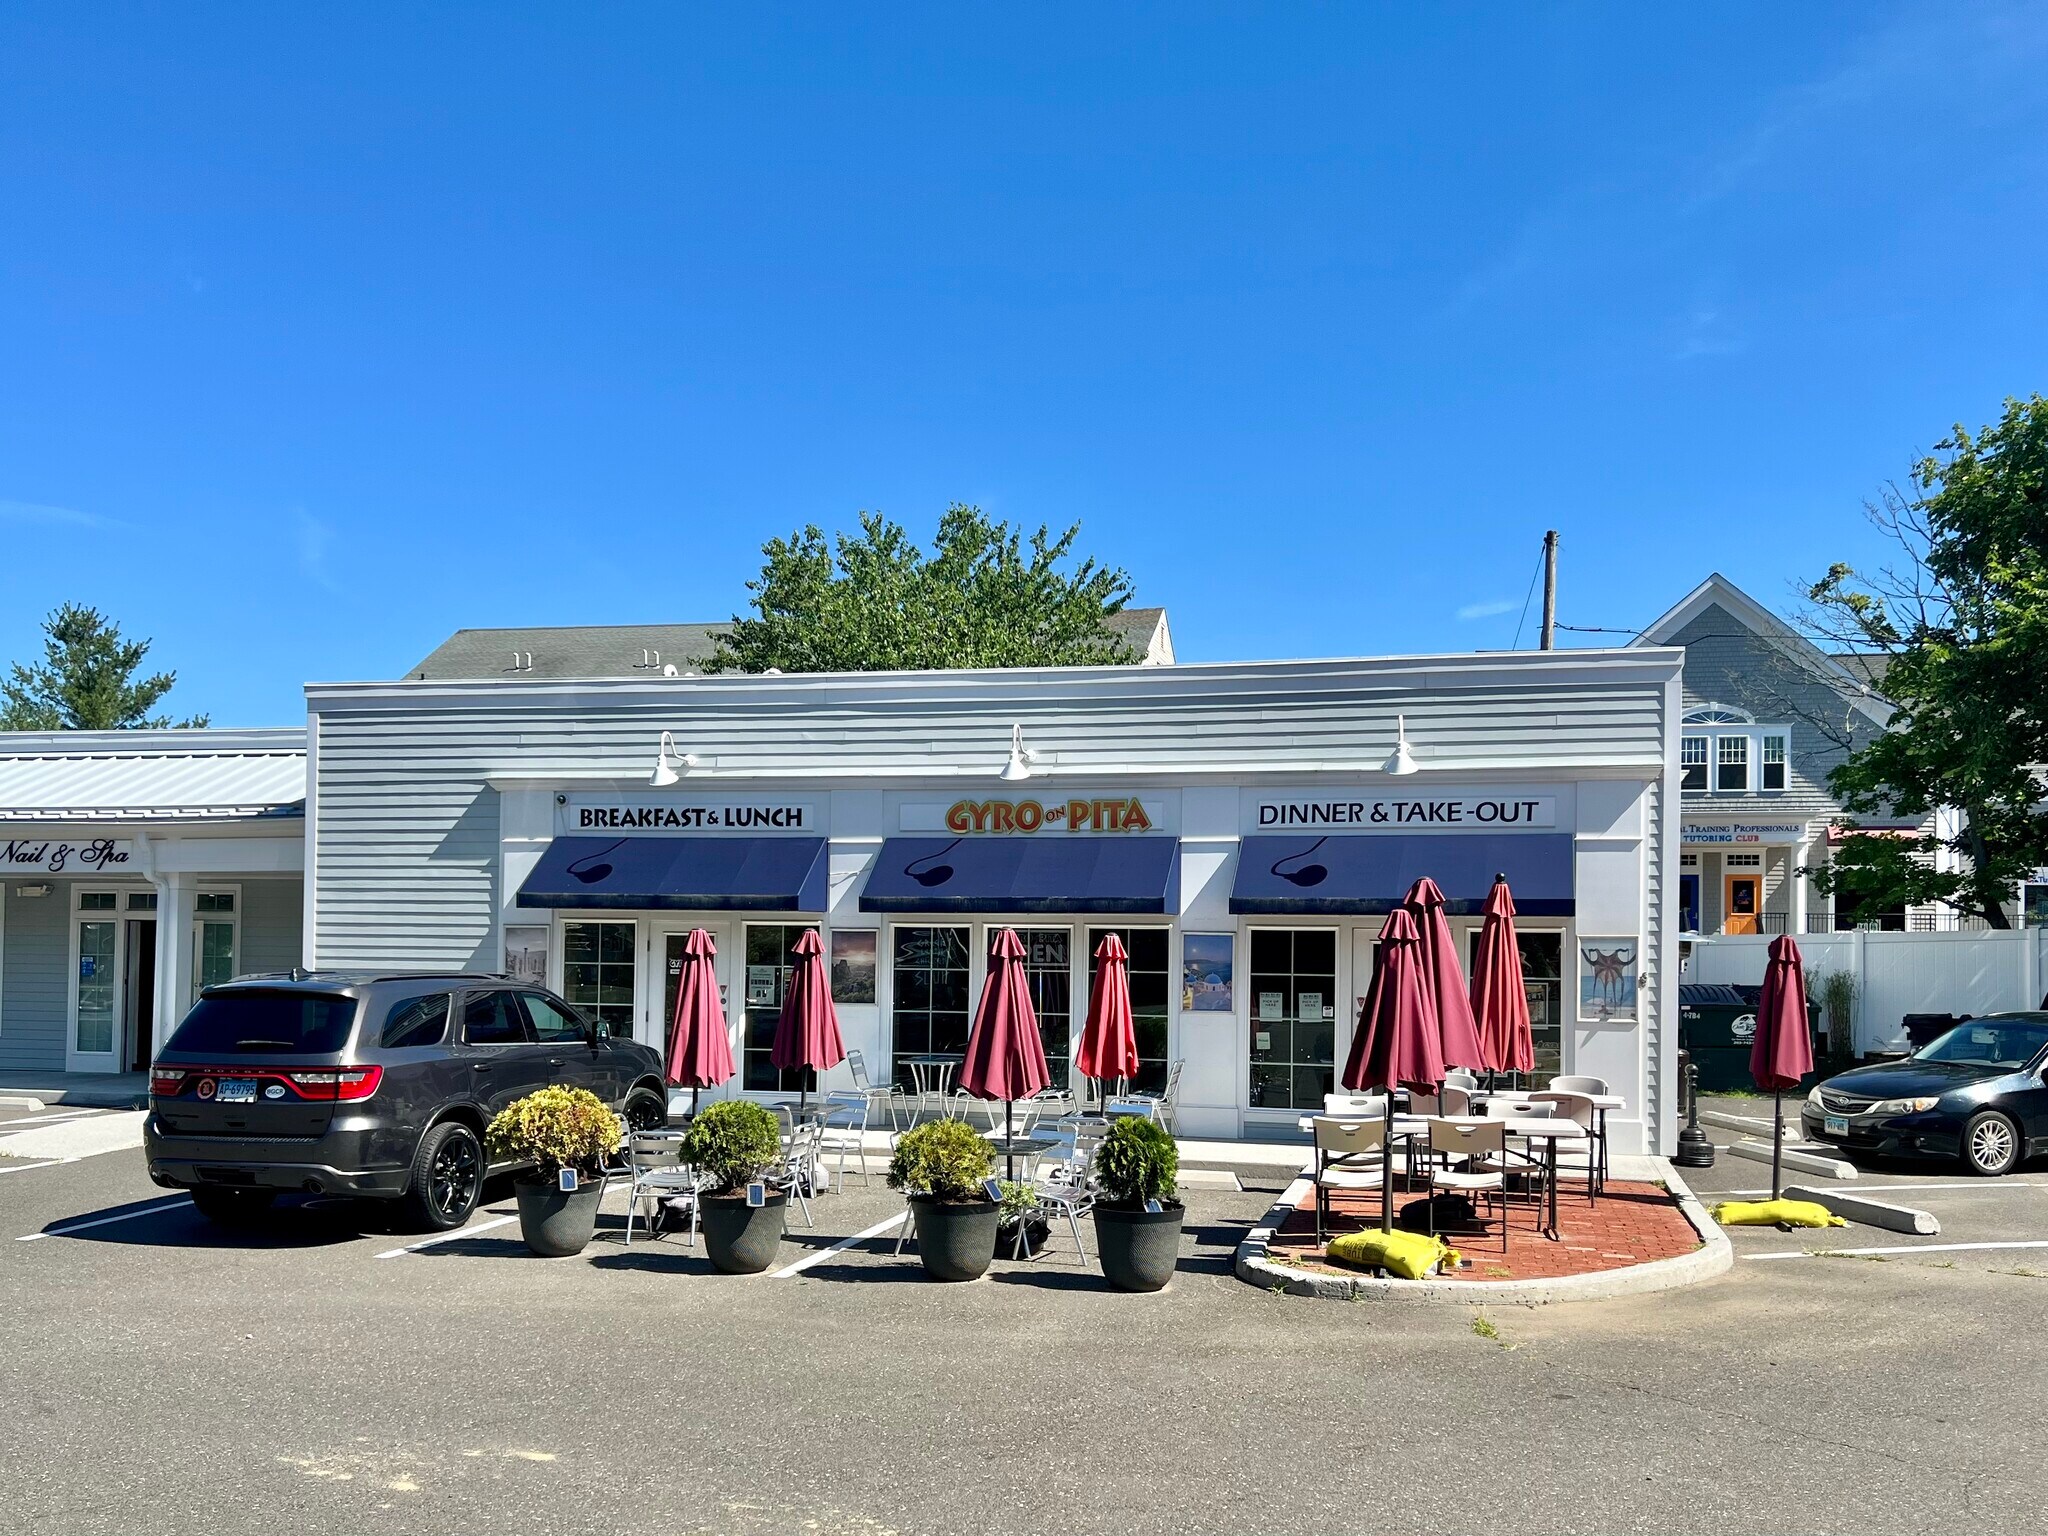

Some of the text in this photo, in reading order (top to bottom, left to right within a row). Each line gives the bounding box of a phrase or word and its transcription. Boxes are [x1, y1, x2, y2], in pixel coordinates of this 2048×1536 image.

[580, 808, 706, 828] BREAKFAST
[724, 807, 803, 827] LUNCH
[945, 797, 1153, 834] GYRO ON PITA
[1259, 803, 1364, 825] DINNER
[1392, 801, 1540, 823] TAKE-OUT
[1683, 834, 1760, 843] TUTORING CLUB
[0, 840, 49, 863] Nail
[80, 838, 129, 871] Spa
